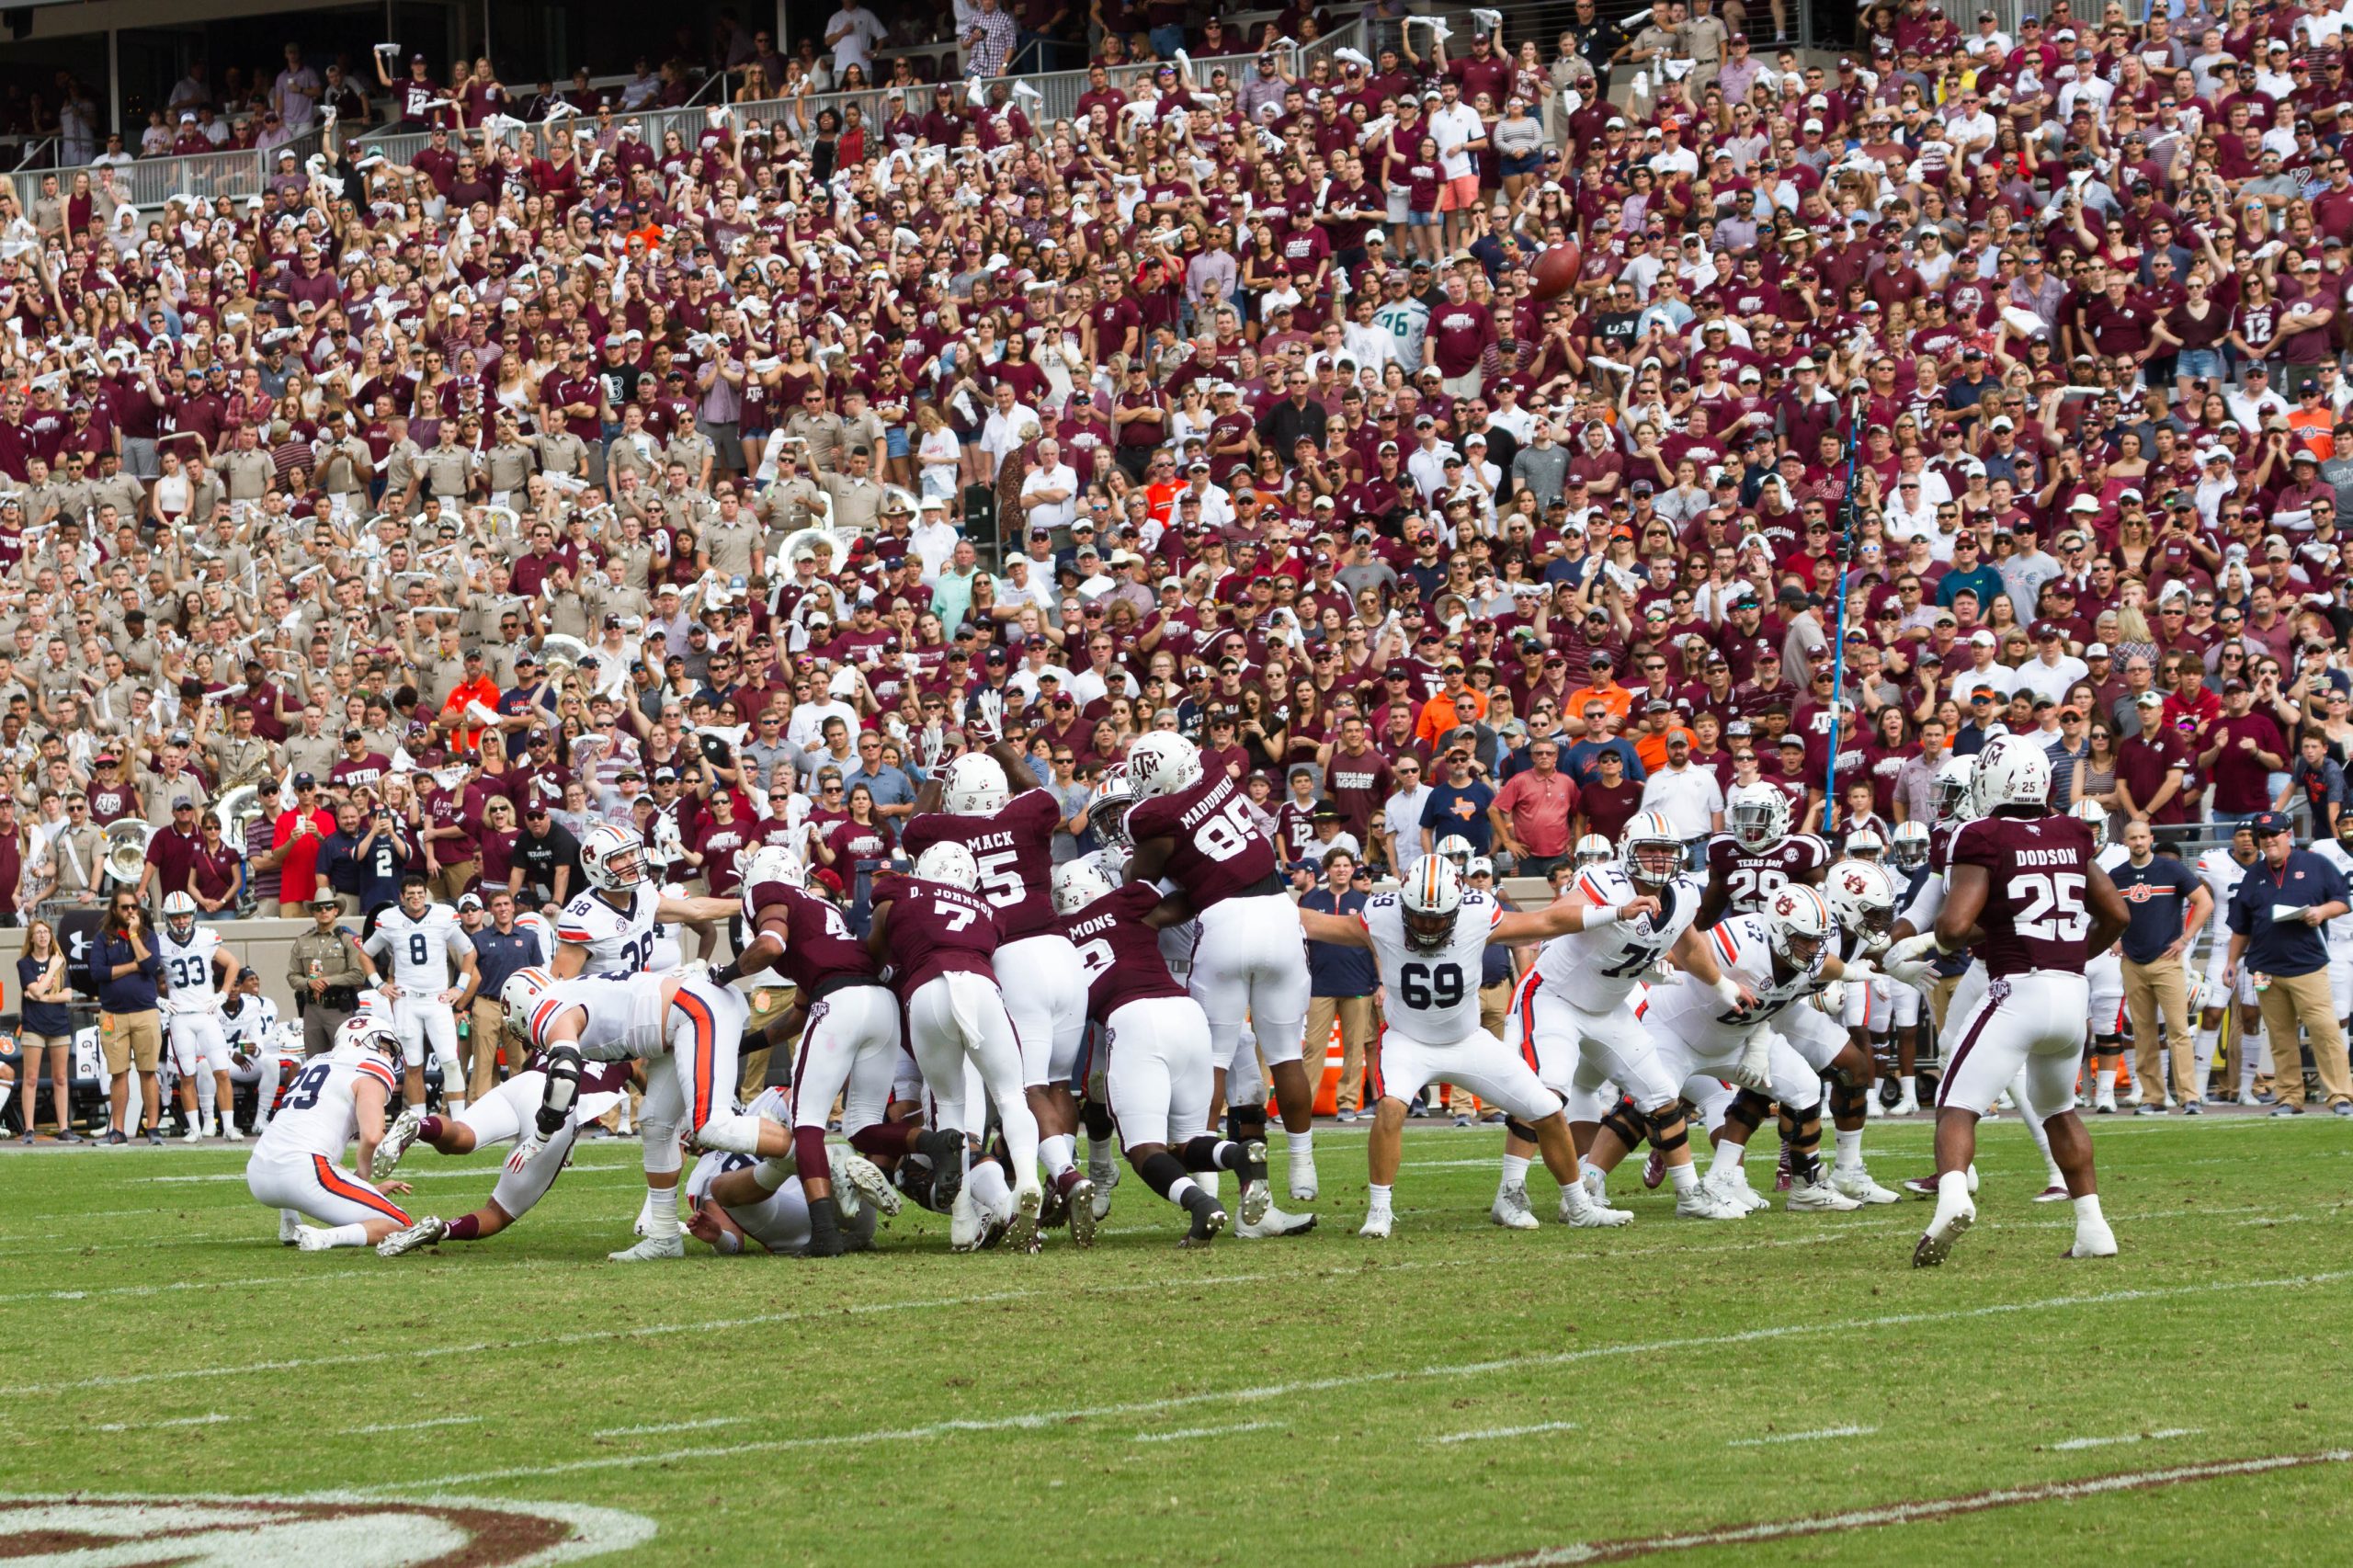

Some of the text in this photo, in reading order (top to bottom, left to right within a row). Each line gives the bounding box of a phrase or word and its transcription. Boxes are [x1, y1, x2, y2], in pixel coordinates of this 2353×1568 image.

[406, 94, 427, 115] 12
[2290, 165, 2312, 191] 12
[1287, 239, 1313, 247] TEXAS
[1382, 312, 1408, 336] 76
[2245, 317, 2271, 343] 12
[346, 767, 381, 787] BTHO
[1336, 779, 1373, 789] AGGIES
[1357, 772, 1375, 780] A&M
[2022, 781, 2035, 793] 25
[985, 801, 993, 811] 5
[966, 831, 1015, 854] MACK
[1291, 823, 1314, 847] 12
[378, 848, 392, 878] 2
[1737, 858, 1784, 869] TEXAS A&M
[2016, 847, 2078, 867] DODSON
[957, 868, 963, 878] 7
[977, 849, 1027, 908] 5
[1727, 869, 1790, 913] 29
[566, 900, 593, 917] 38
[910, 886, 994, 922] D. JOHNSON
[933, 899, 977, 932] 7
[2006, 872, 2092, 942] 25
[825, 907, 858, 941] 4
[410, 934, 427, 965] 8
[171, 955, 206, 988] 33
[1401, 962, 1464, 1011] 69
[280, 1063, 331, 1109] 29
